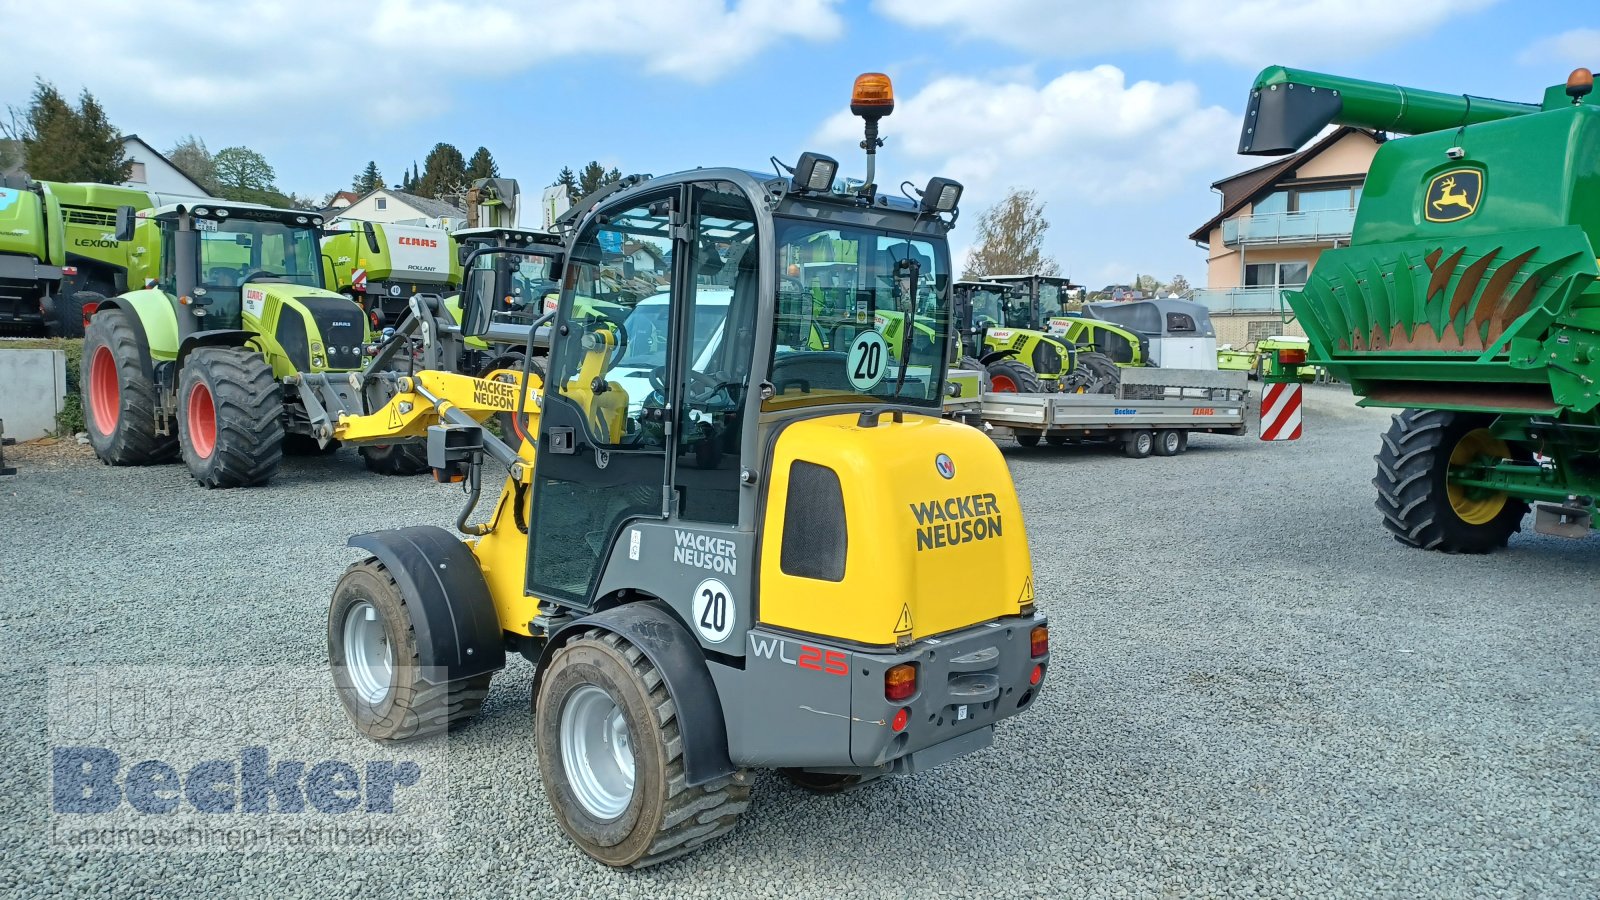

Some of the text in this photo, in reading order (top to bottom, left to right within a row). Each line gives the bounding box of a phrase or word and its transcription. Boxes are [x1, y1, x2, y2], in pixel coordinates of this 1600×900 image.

[75, 239, 119, 249] LEXION
[399, 236, 438, 248] CLAAS
[407, 264, 437, 272] ROLLANT
[392, 286, 400, 294] 40
[854, 341, 881, 379] 20
[473, 379, 514, 398] WACKER
[473, 391, 515, 411] NEUSON
[1192, 407, 1214, 416] CLAAS
[909, 493, 1001, 526] WACKER
[916, 515, 1003, 551] NEUSON
[674, 529, 737, 559] WACKER
[673, 546, 737, 576] NEUSON
[700, 588, 727, 633] 20
